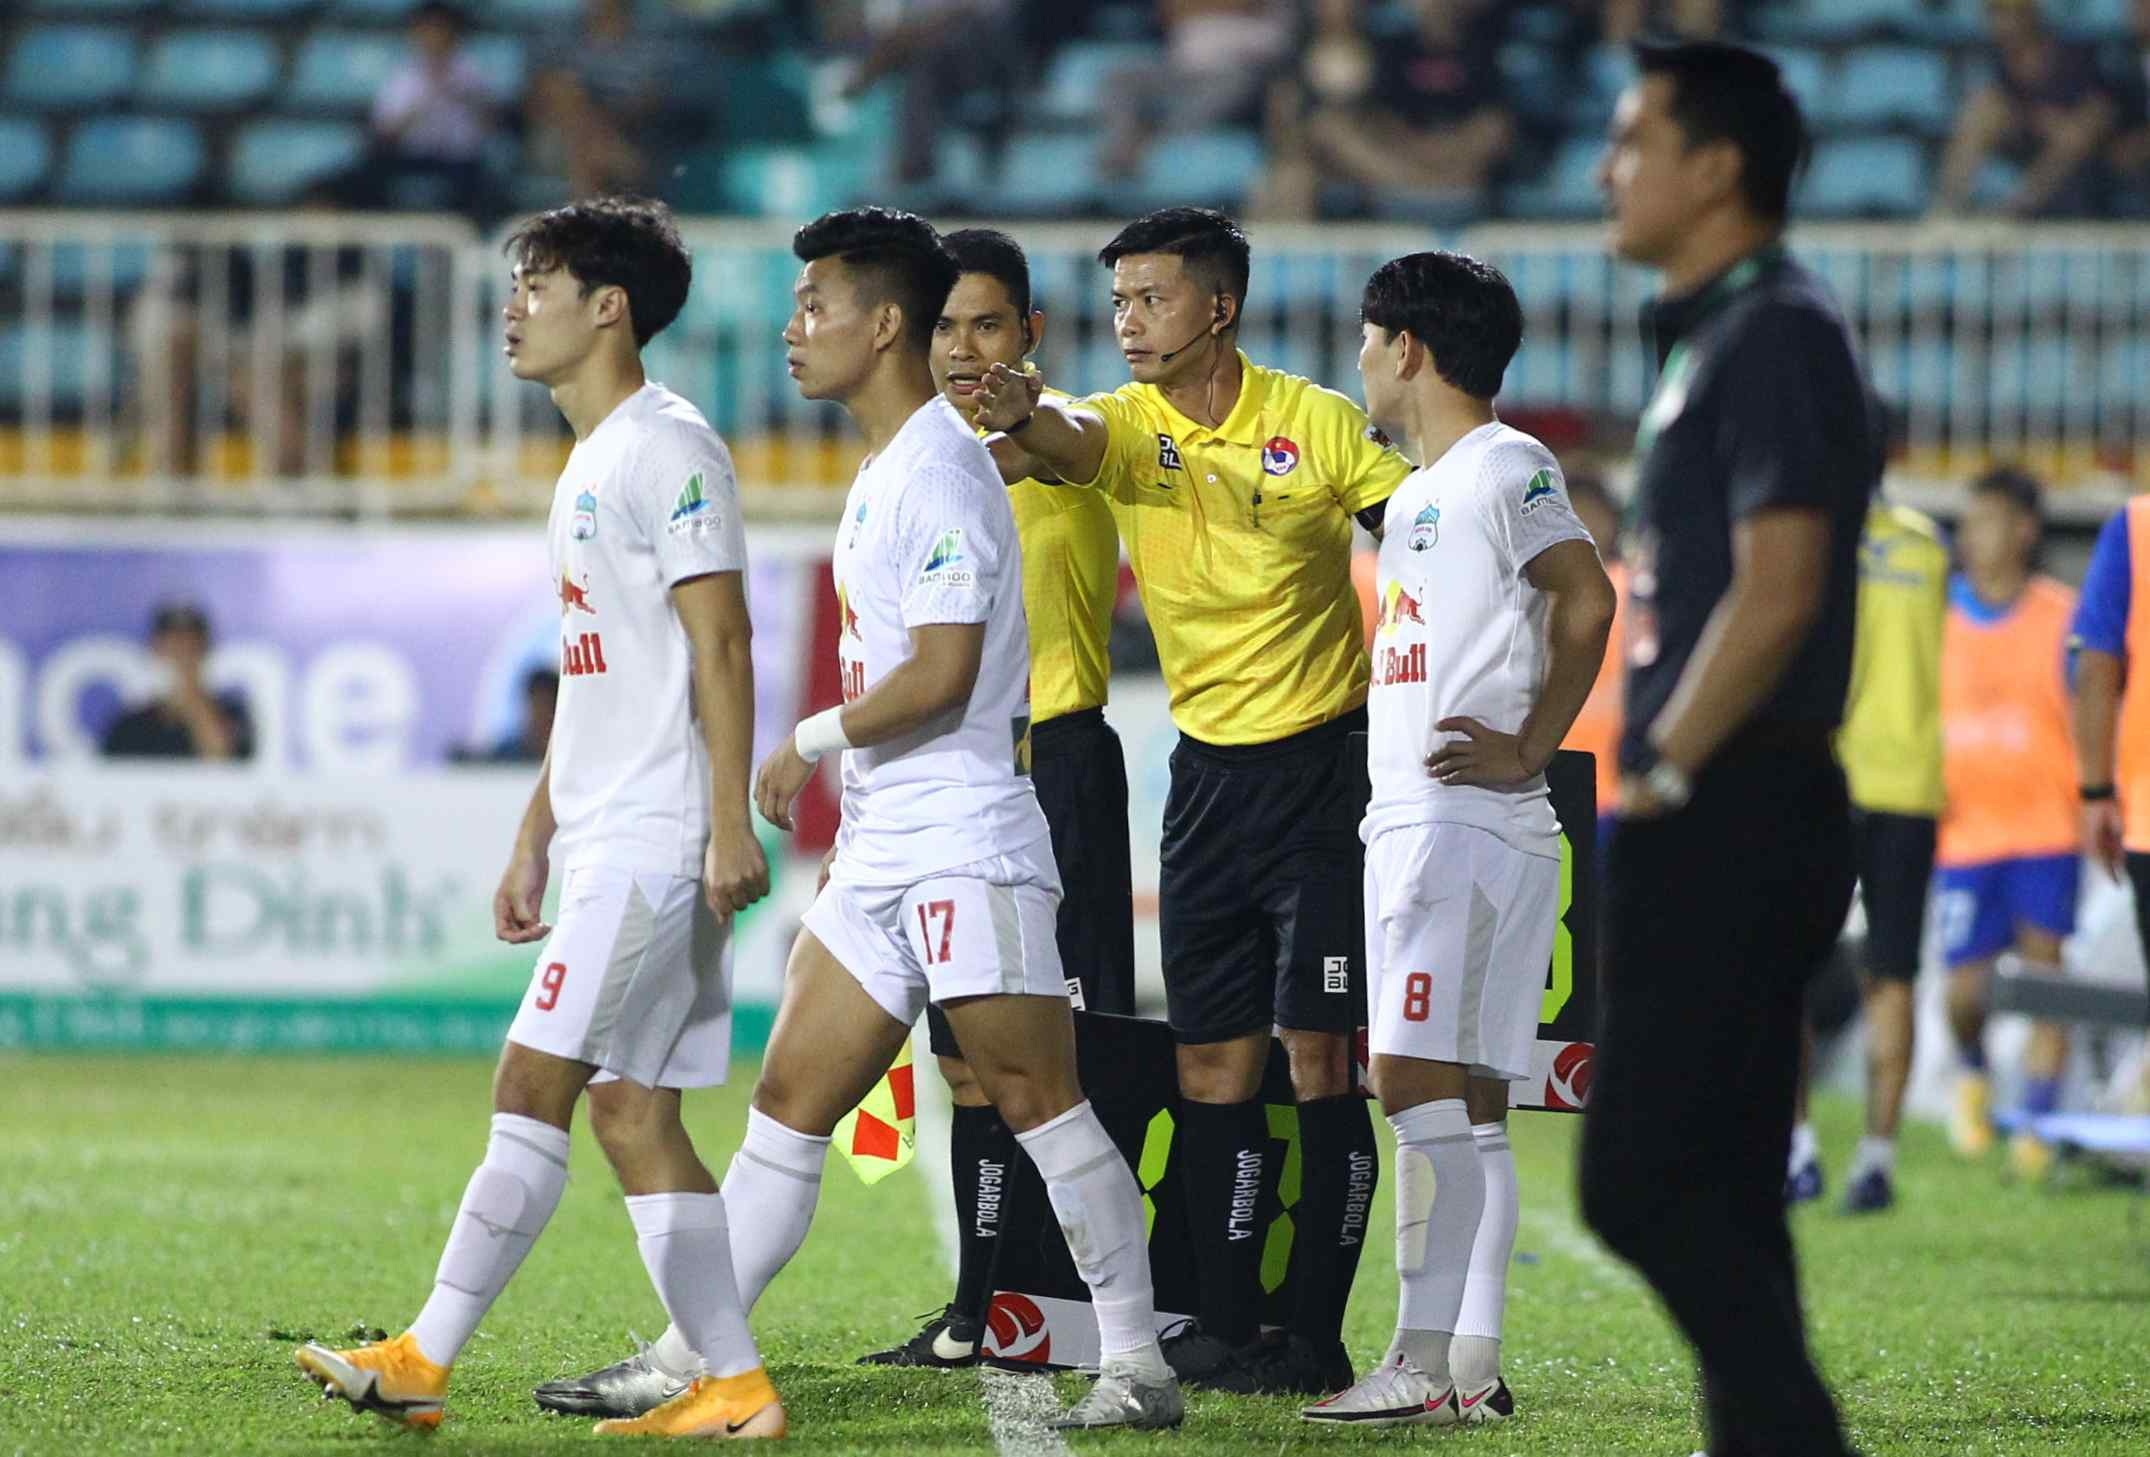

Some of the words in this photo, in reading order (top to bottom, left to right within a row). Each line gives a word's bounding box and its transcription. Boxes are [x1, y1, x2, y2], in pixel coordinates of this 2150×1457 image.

[917, 899, 955, 965] 17
[535, 962, 567, 1011] 9
[1403, 972, 1433, 1022] 8
[976, 1159, 1005, 1237] JOGARBOLA
[1228, 1149, 1263, 1241] JOGARBOLA
[1339, 1151, 1372, 1247] JOGARBOLA
